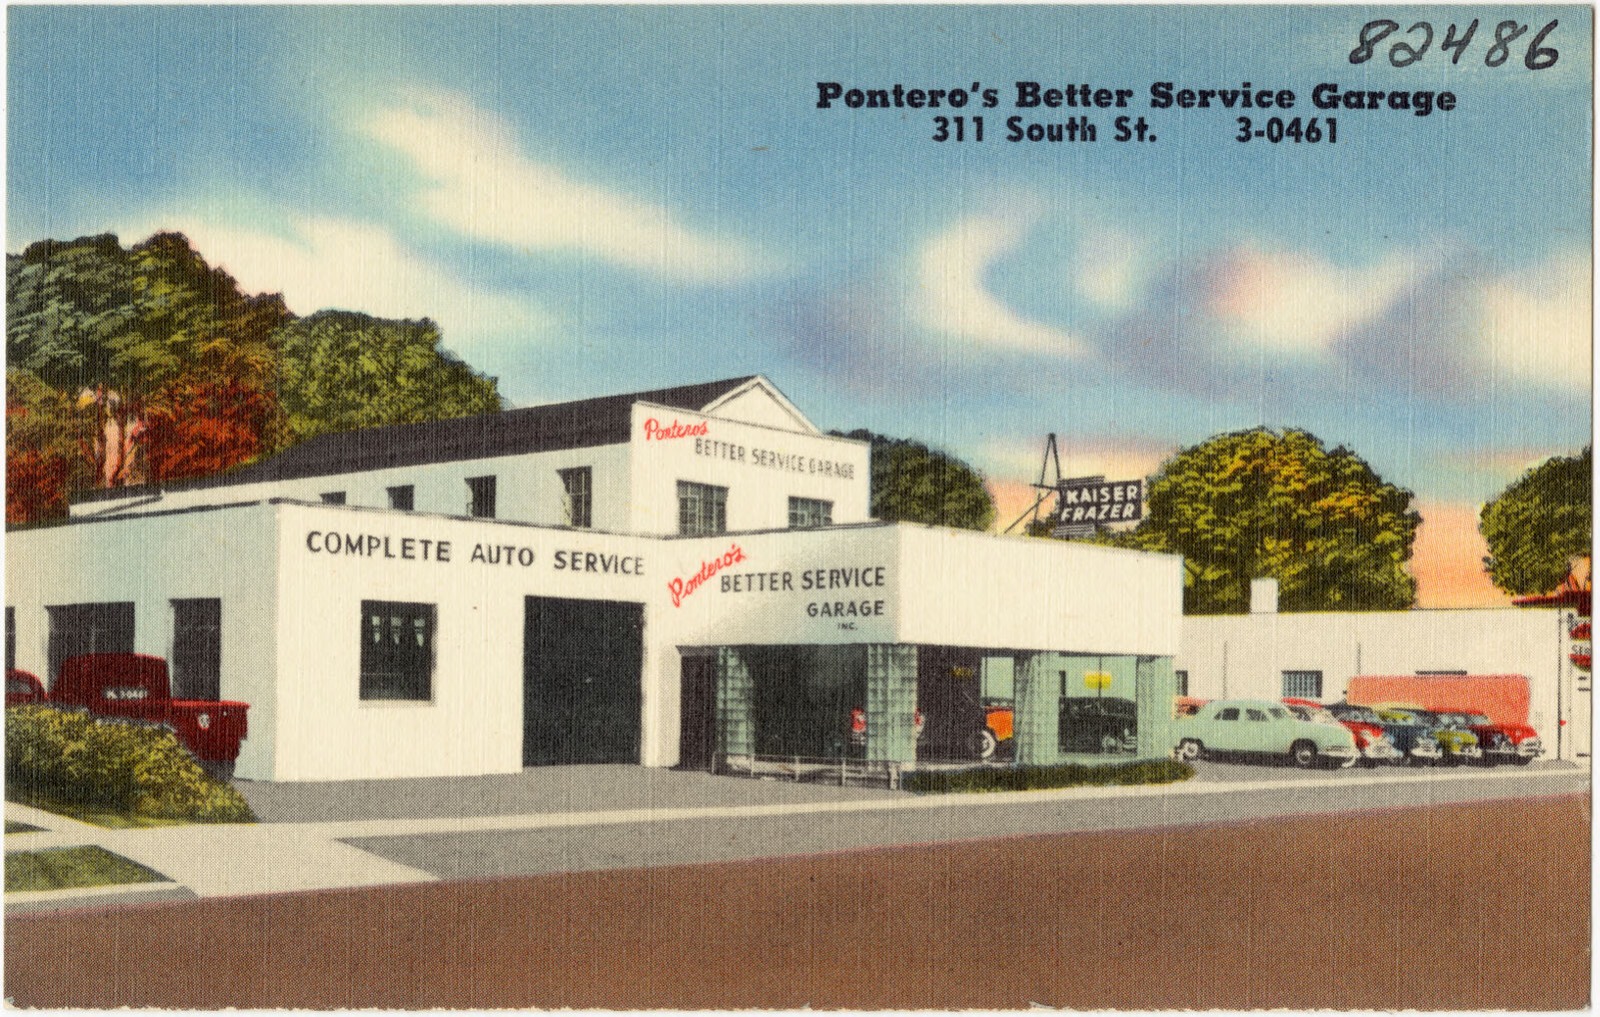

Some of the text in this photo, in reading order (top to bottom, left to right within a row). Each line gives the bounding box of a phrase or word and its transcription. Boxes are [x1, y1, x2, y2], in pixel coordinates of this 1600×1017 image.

[1349, 19, 1560, 70] 82486
[695, 437, 855, 480] BETTER SERVICE GARAGE
[1066, 485, 1138, 504] KAISER
[1060, 503, 1135, 522] FRAZER
[306, 530, 645, 576] COMPLETE AUTO SERVICE
[667, 543, 746, 608] Pontero's
[720, 567, 886, 594] BETTER SERVICE
[806, 600, 885, 618] GARAGE
